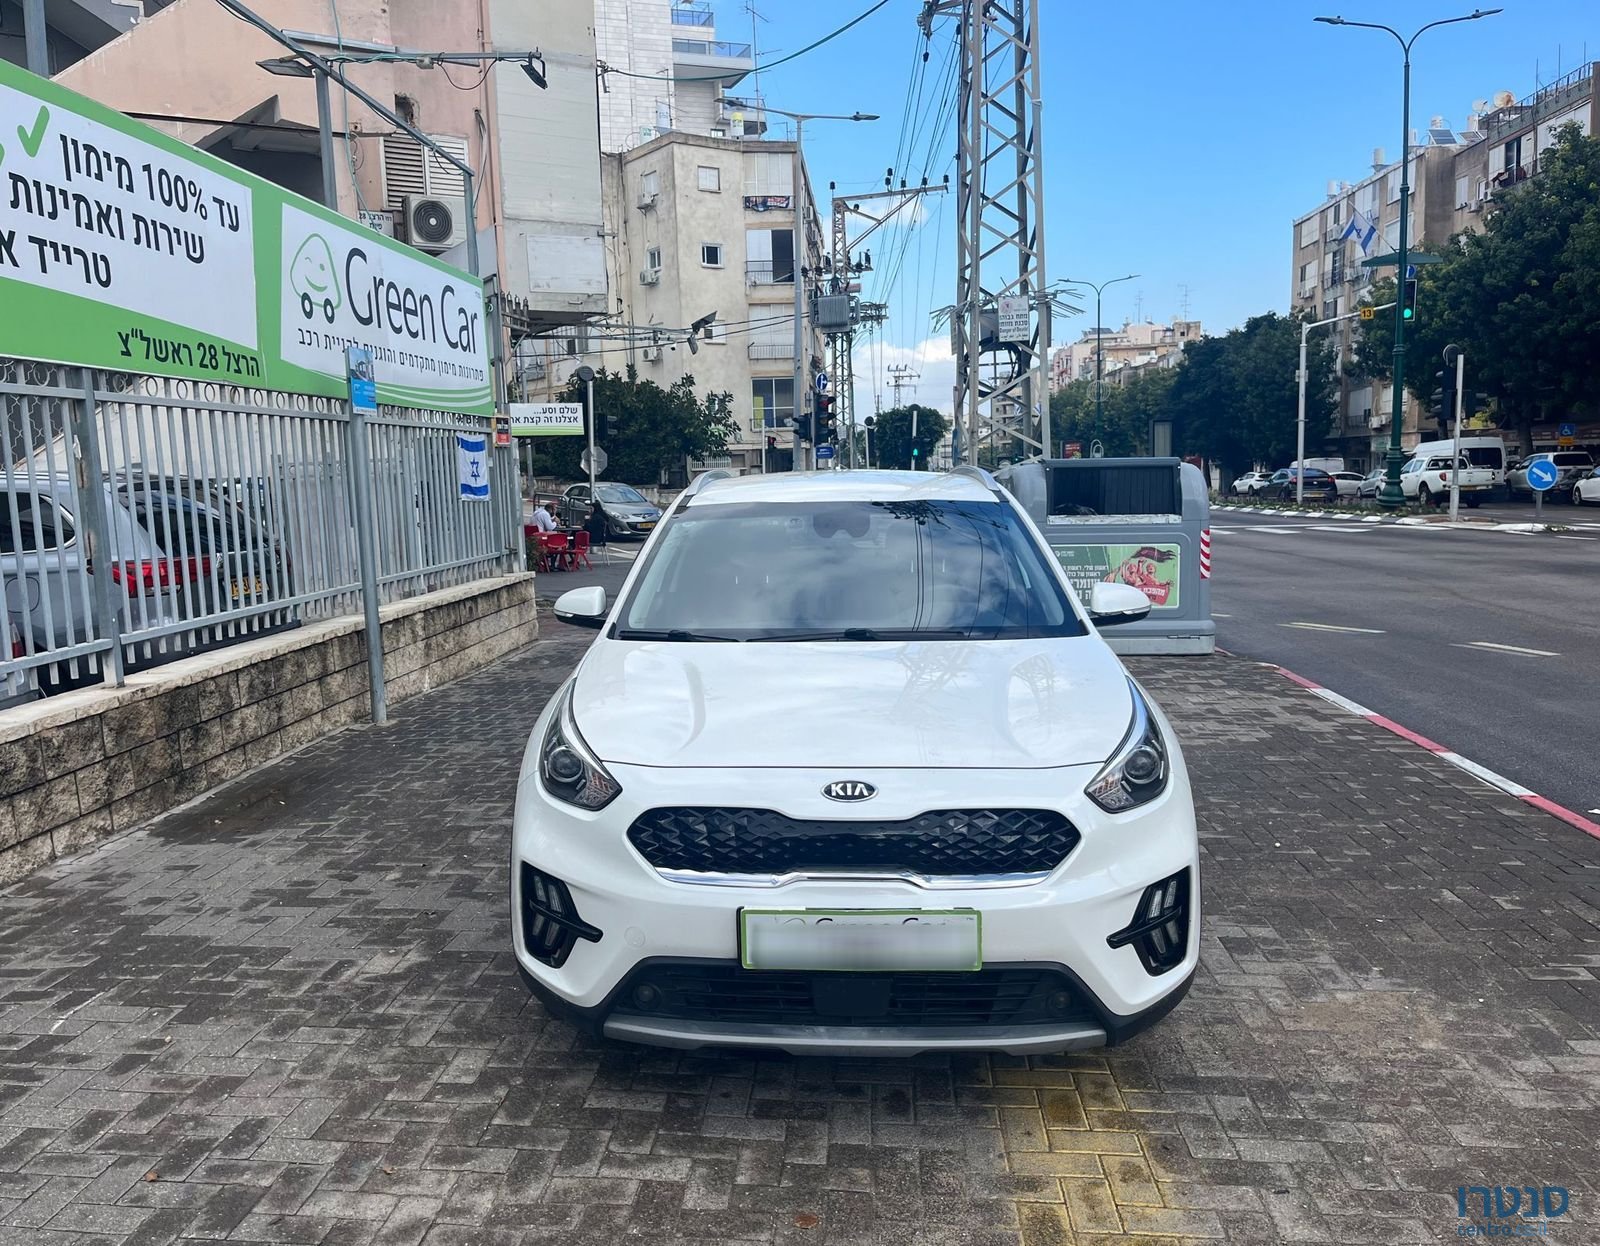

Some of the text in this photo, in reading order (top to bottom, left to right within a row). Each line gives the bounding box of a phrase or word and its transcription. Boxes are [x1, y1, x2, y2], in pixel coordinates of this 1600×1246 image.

[59, 133, 240, 232] עד 100% מימון
[8, 171, 205, 264] שירות ואמינות
[28, 234, 112, 288] טרייד
[345, 247, 478, 355] Green Car
[1362, 309, 1372, 318] 13
[298, 328, 320, 348] רכב
[197, 341, 219, 370] 28
[222, 345, 260, 378] הרצל
[400, 351, 436, 371] מתקדמים
[438, 358, 457, 377] מימון
[458, 363, 484, 382] פתרונות
[555, 414, 579, 424] אצלנו
[559, 405, 578, 415] שלם
[523, 416, 541, 426] קצת
[543, 416, 553, 424] זה
[831, 783, 869, 797] KIA
